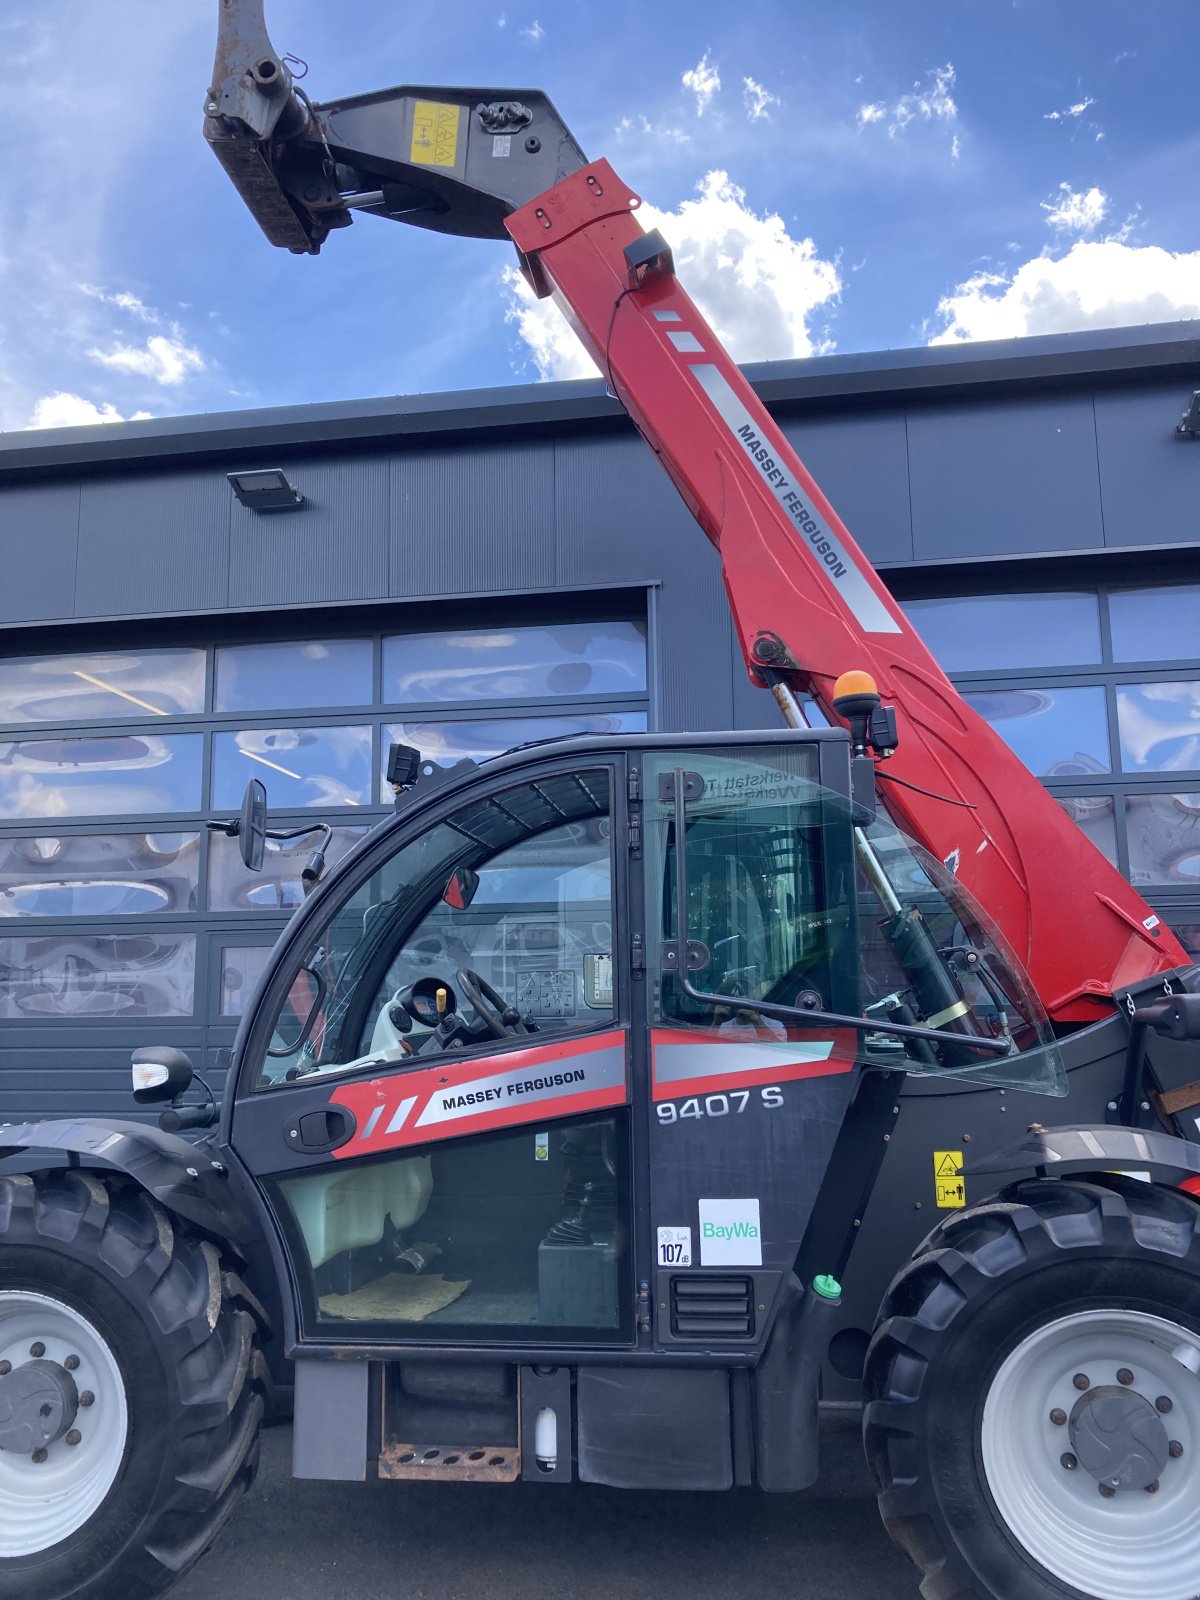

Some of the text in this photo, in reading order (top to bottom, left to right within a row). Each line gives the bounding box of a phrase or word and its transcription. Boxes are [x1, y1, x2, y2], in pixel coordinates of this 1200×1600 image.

[738, 424, 847, 578] MASSEY FERGUSON
[443, 1070, 585, 1110] MASSEY FERGUSON
[656, 1086, 784, 1125] 9407 S
[703, 1223, 758, 1240] BayWa
[660, 1244, 683, 1263] 107
